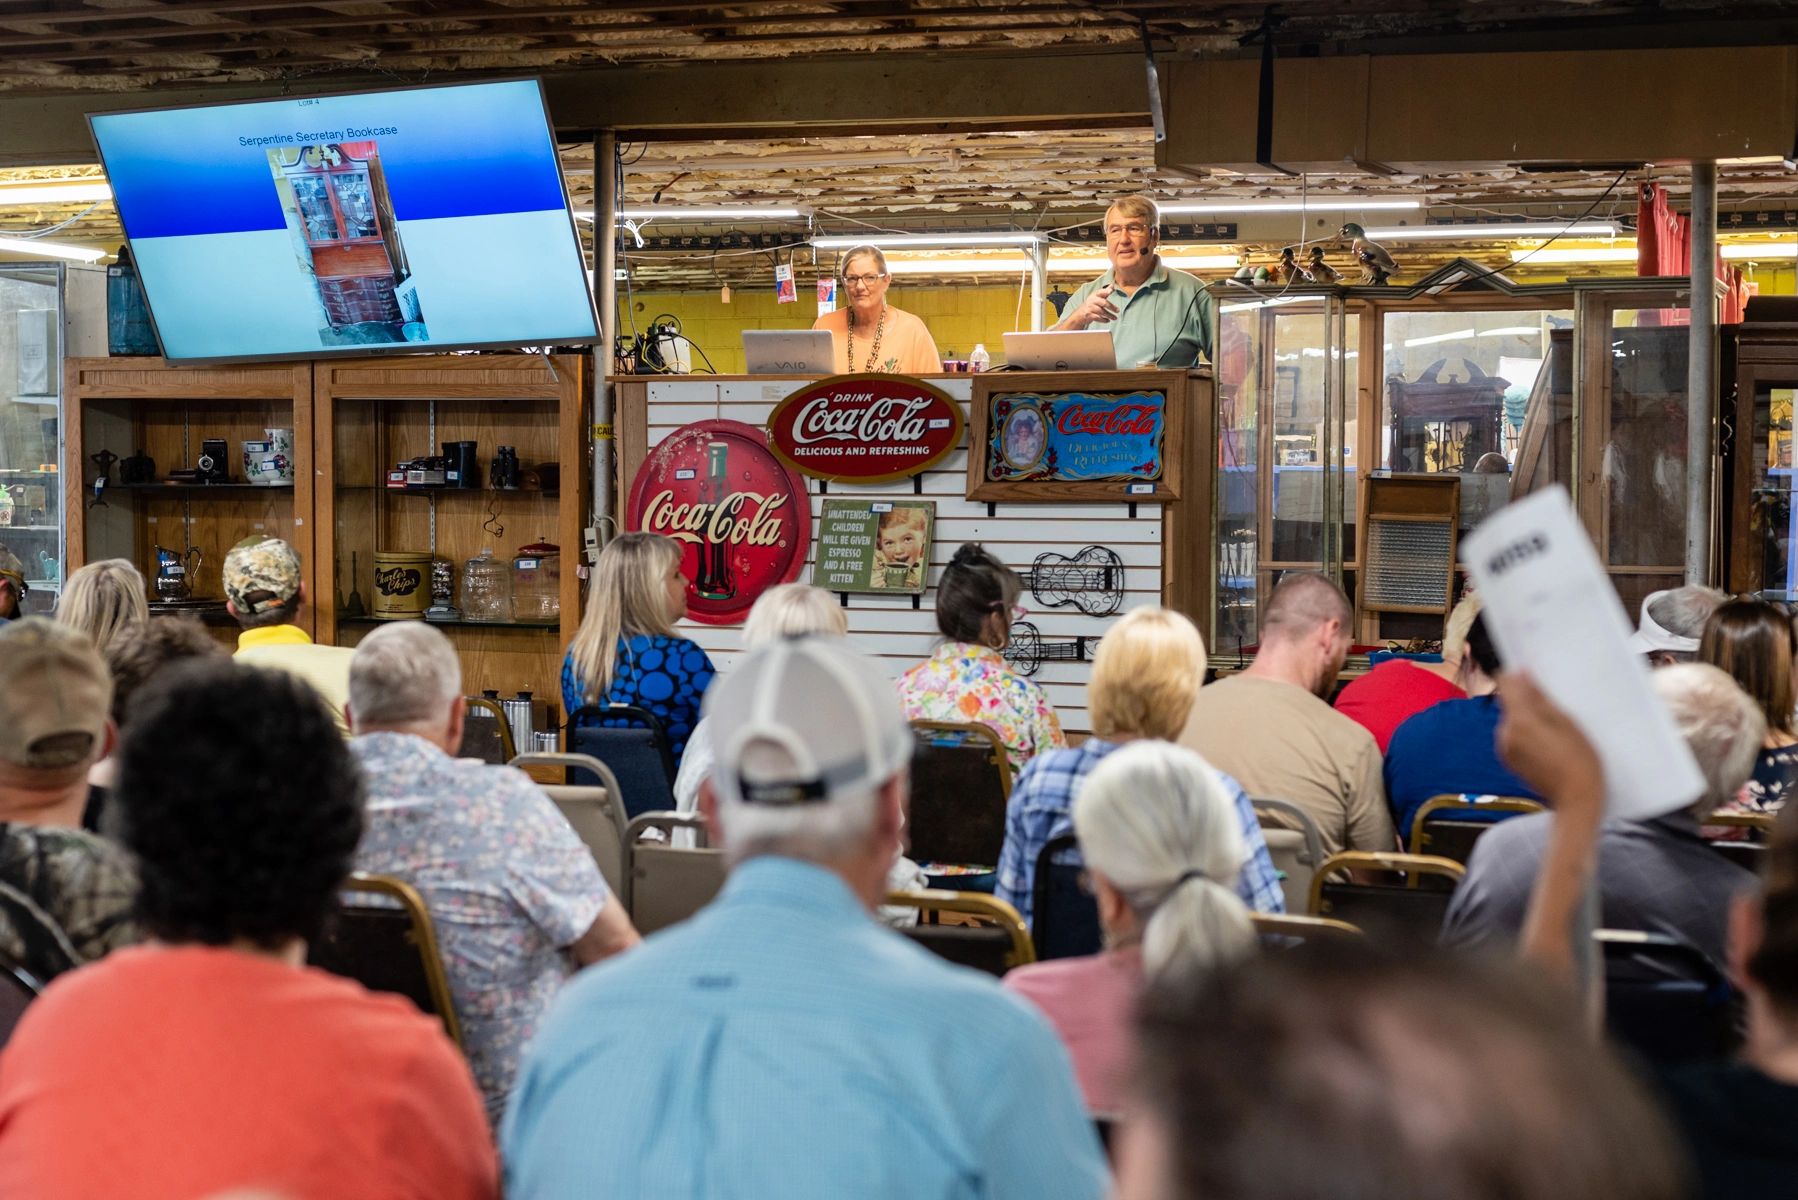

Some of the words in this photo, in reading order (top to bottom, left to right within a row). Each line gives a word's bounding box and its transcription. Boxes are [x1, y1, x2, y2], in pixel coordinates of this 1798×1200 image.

[238, 134, 293, 147] Serpentine
[296, 130, 344, 142] Secretary
[347, 126, 398, 138] Bookcase
[774, 361, 806, 370] VAIO
[833, 393, 874, 402] DRINK
[791, 396, 933, 444] Coca-Cola
[794, 447, 843, 456] DELICIOUS
[845, 446, 866, 456] AND
[869, 446, 930, 455] REFRESHING
[828, 509, 872, 520] UNATTENDED
[831, 522, 865, 533] CHILDREN
[822, 535, 838, 545] WILL
[840, 535, 849, 545] BE
[850, 536, 871, 546] GIVEN
[828, 548, 861, 558] ESPRESSO
[823, 561, 838, 570] AND
[840, 561, 845, 570] A
[846, 561, 864, 571] FREE
[376, 569, 407, 585] Charles
[830, 573, 854, 584] KITTEN
[388, 575, 416, 592] Chips
